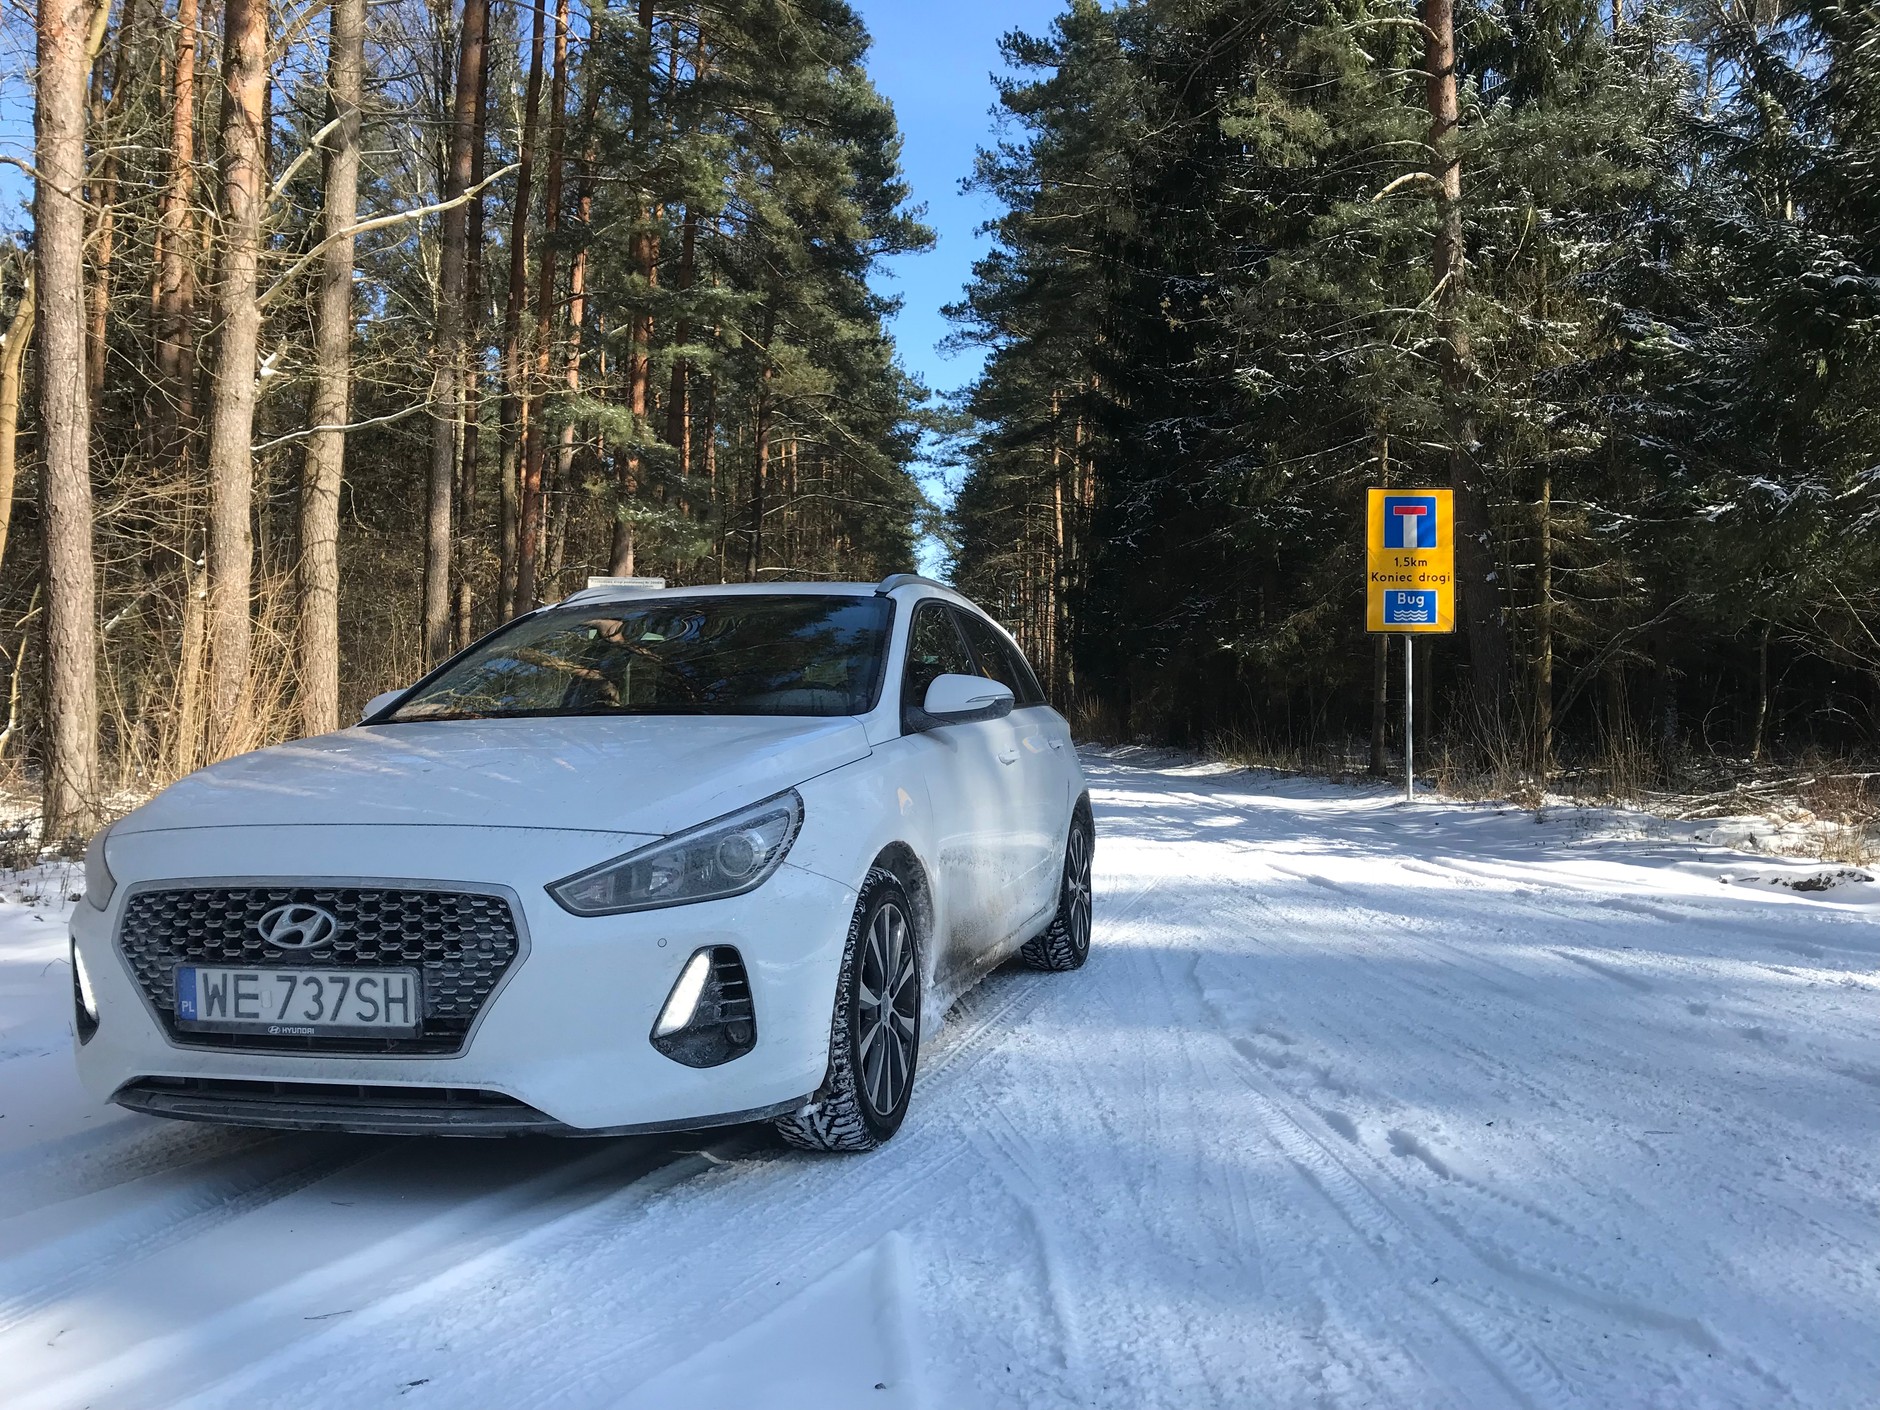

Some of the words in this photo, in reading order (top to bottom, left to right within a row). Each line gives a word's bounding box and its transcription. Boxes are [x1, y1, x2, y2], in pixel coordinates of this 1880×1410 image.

[1394, 557, 1428, 568] 1,5km
[1371, 572, 1413, 583] Koniec
[1418, 571, 1450, 584] drogi
[1397, 592, 1425, 607] Bug
[202, 973, 260, 1019] WE
[276, 975, 410, 1024] 737SH
[181, 1000, 195, 1013] PL
[281, 1026, 315, 1035] HYUNDAI
